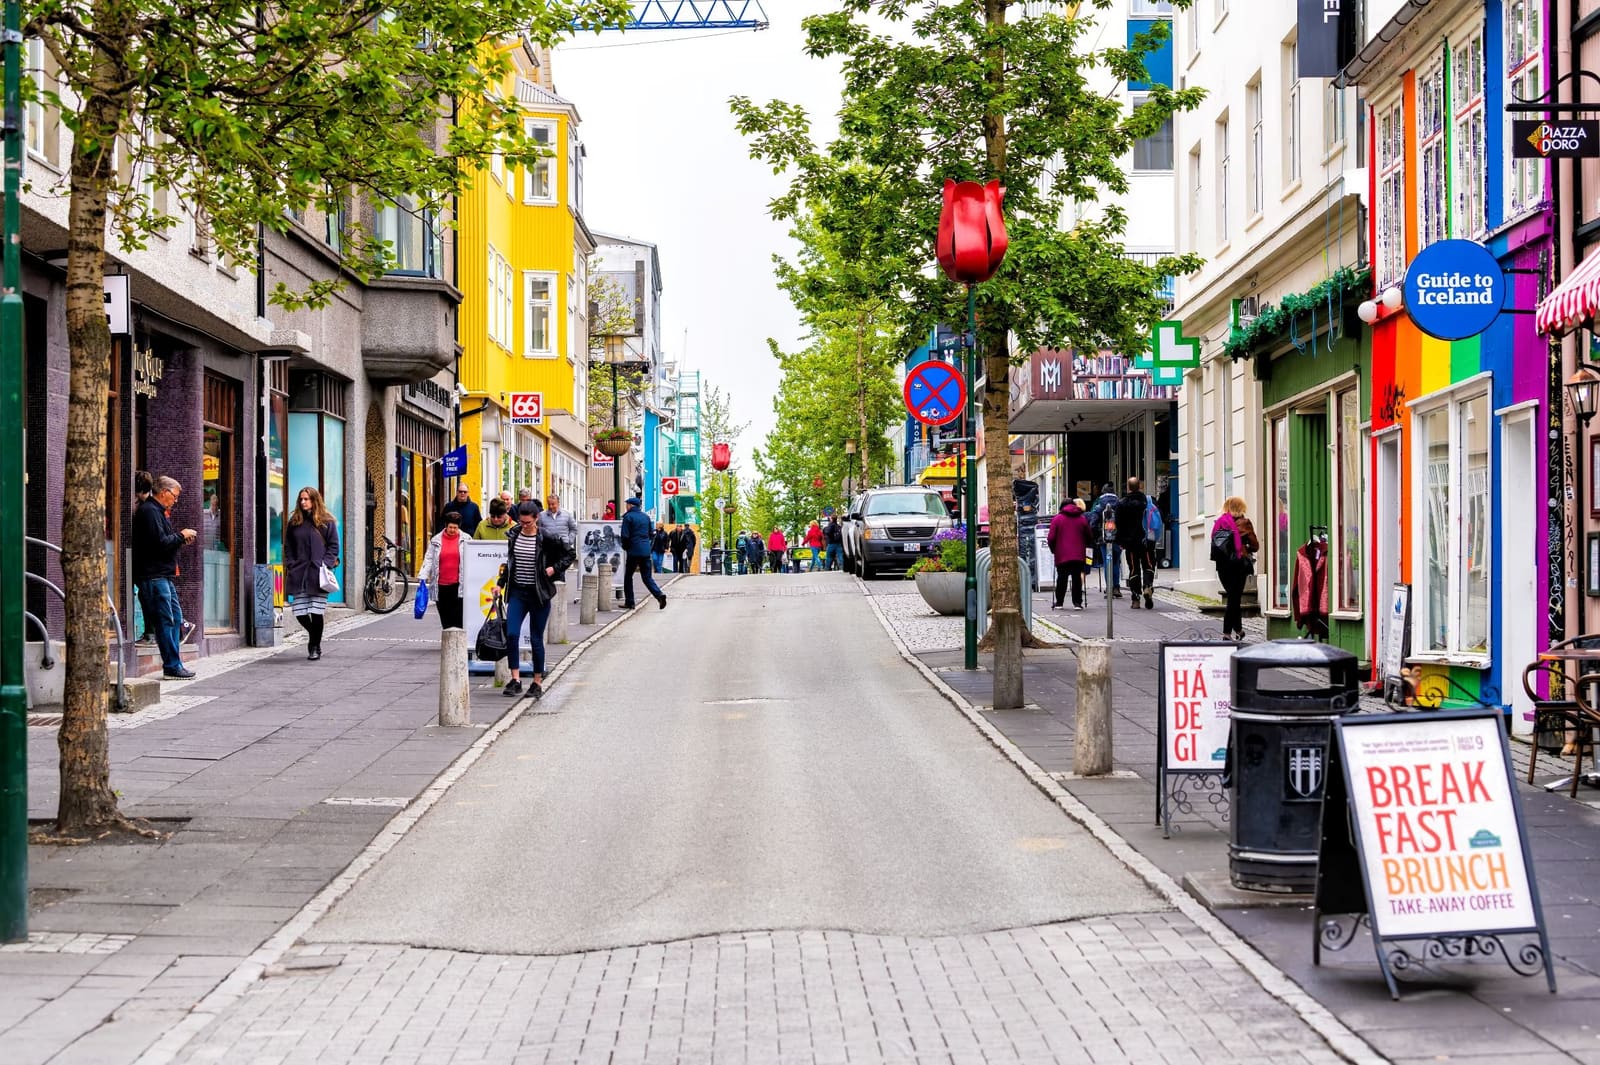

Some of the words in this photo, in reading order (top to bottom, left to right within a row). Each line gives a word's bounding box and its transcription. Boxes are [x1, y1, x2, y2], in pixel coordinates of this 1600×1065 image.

[1541, 125, 1587, 139] PIAZZA
[1417, 272, 1471, 288] Guide
[1474, 273, 1493, 288] to
[1417, 288, 1493, 305] Iceland
[1173, 663, 1208, 698] HÁ
[1174, 701, 1203, 730] DE
[1174, 733, 1197, 762] GI
[1475, 735, 1484, 750] 9
[1365, 760, 1494, 808] BREAK
[1374, 809, 1458, 855] FAST
[1381, 852, 1511, 896] BRUNCH
[1389, 897, 1466, 916] TAKE-AWAY
[1469, 893, 1515, 911] COFFEE
